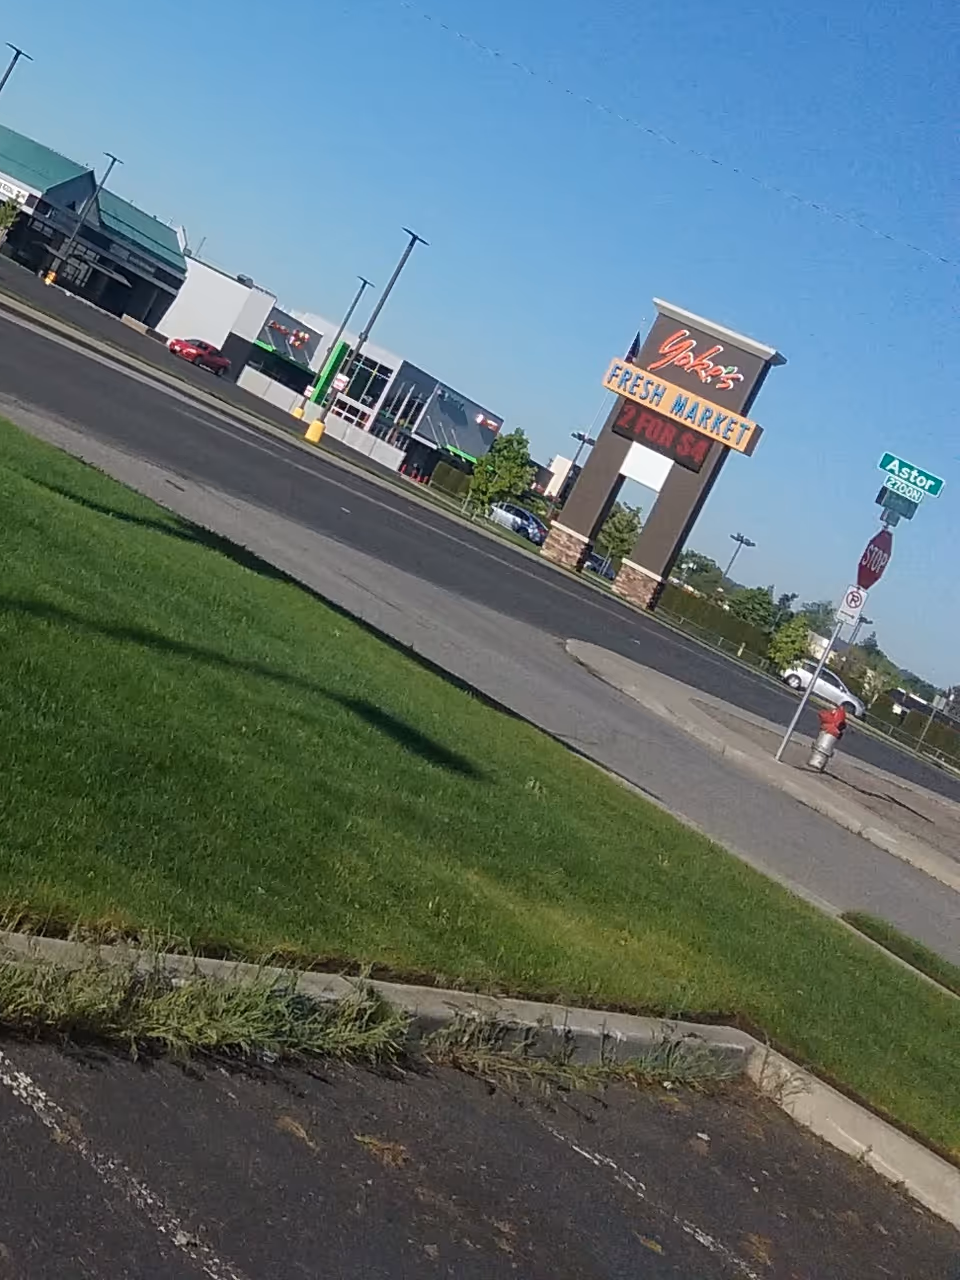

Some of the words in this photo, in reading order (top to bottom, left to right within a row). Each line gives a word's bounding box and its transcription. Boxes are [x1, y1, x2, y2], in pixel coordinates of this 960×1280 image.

[647, 329, 744, 391] Yoke's
[607, 364, 667, 408] FRESH
[669, 393, 751, 446] MARKET
[616, 404, 637, 429] 2
[634, 411, 678, 448] FOR
[885, 459, 936, 491] Astor
[887, 477, 922, 501] 2700N
[861, 544, 889, 574] STOP
